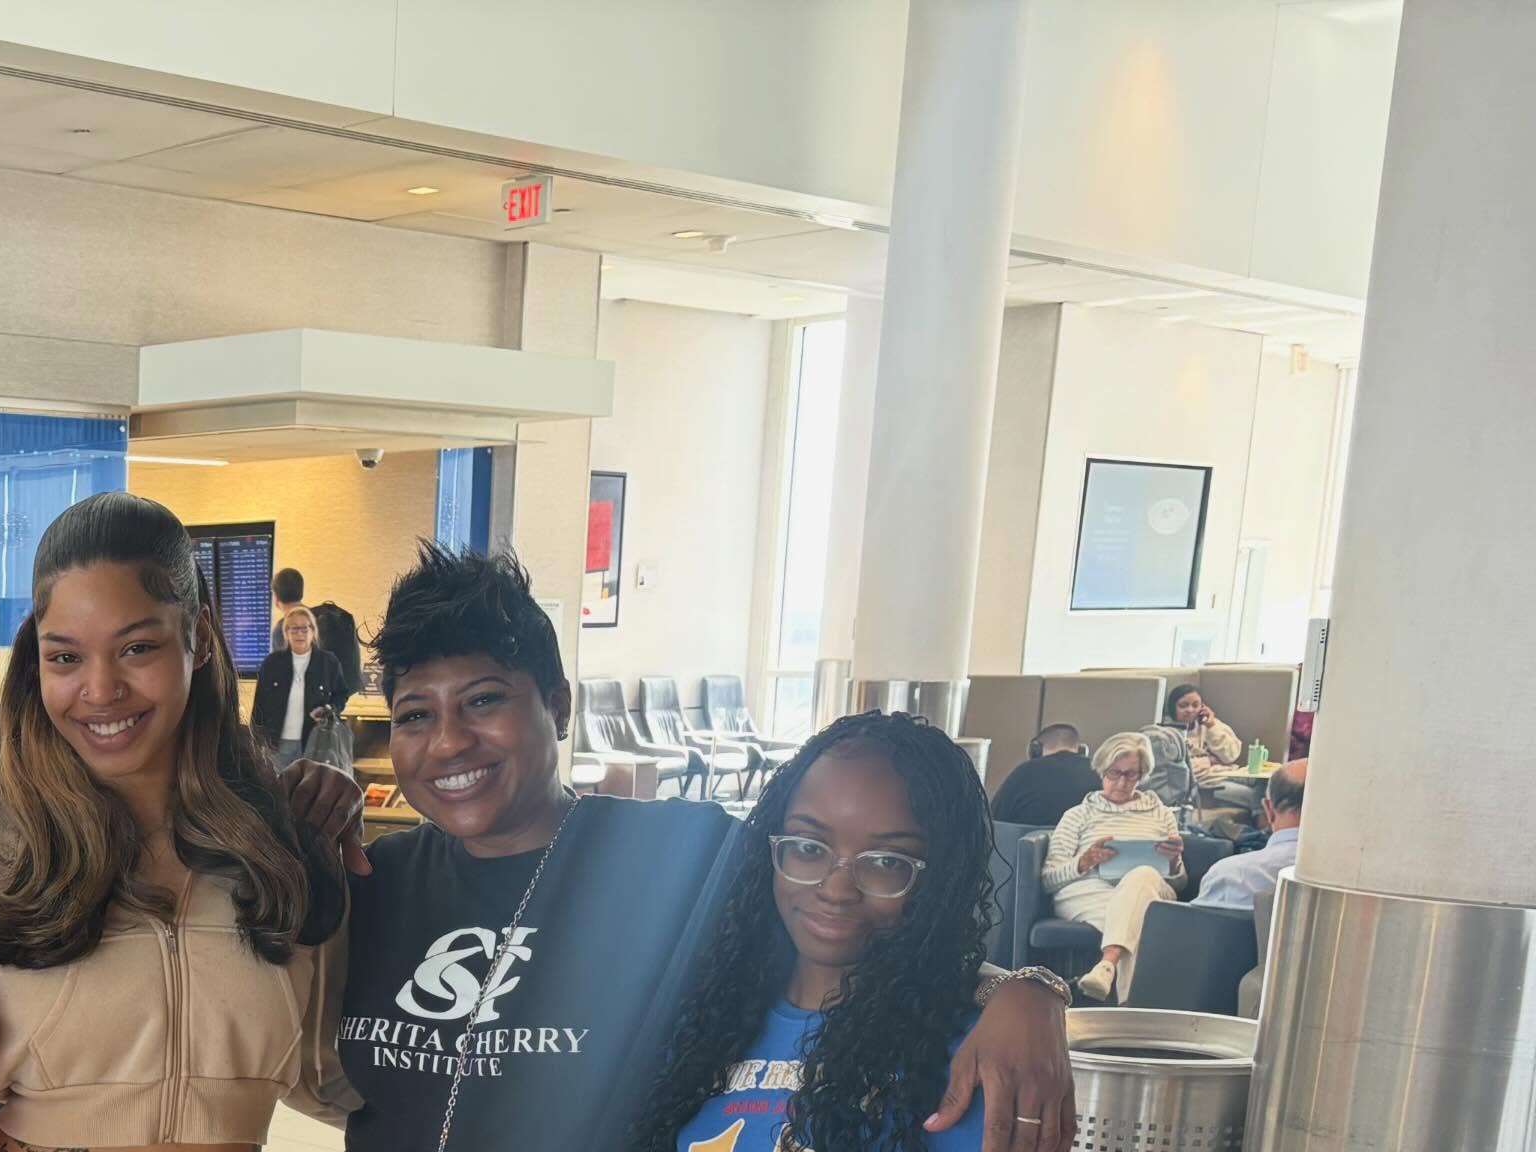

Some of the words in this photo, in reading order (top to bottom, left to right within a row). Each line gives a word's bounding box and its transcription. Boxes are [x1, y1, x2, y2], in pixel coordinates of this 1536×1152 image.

[508, 184, 544, 223] EXIT
[455, 1027, 590, 1055] CHERRY
[373, 1046, 503, 1077] INSTITUTE
